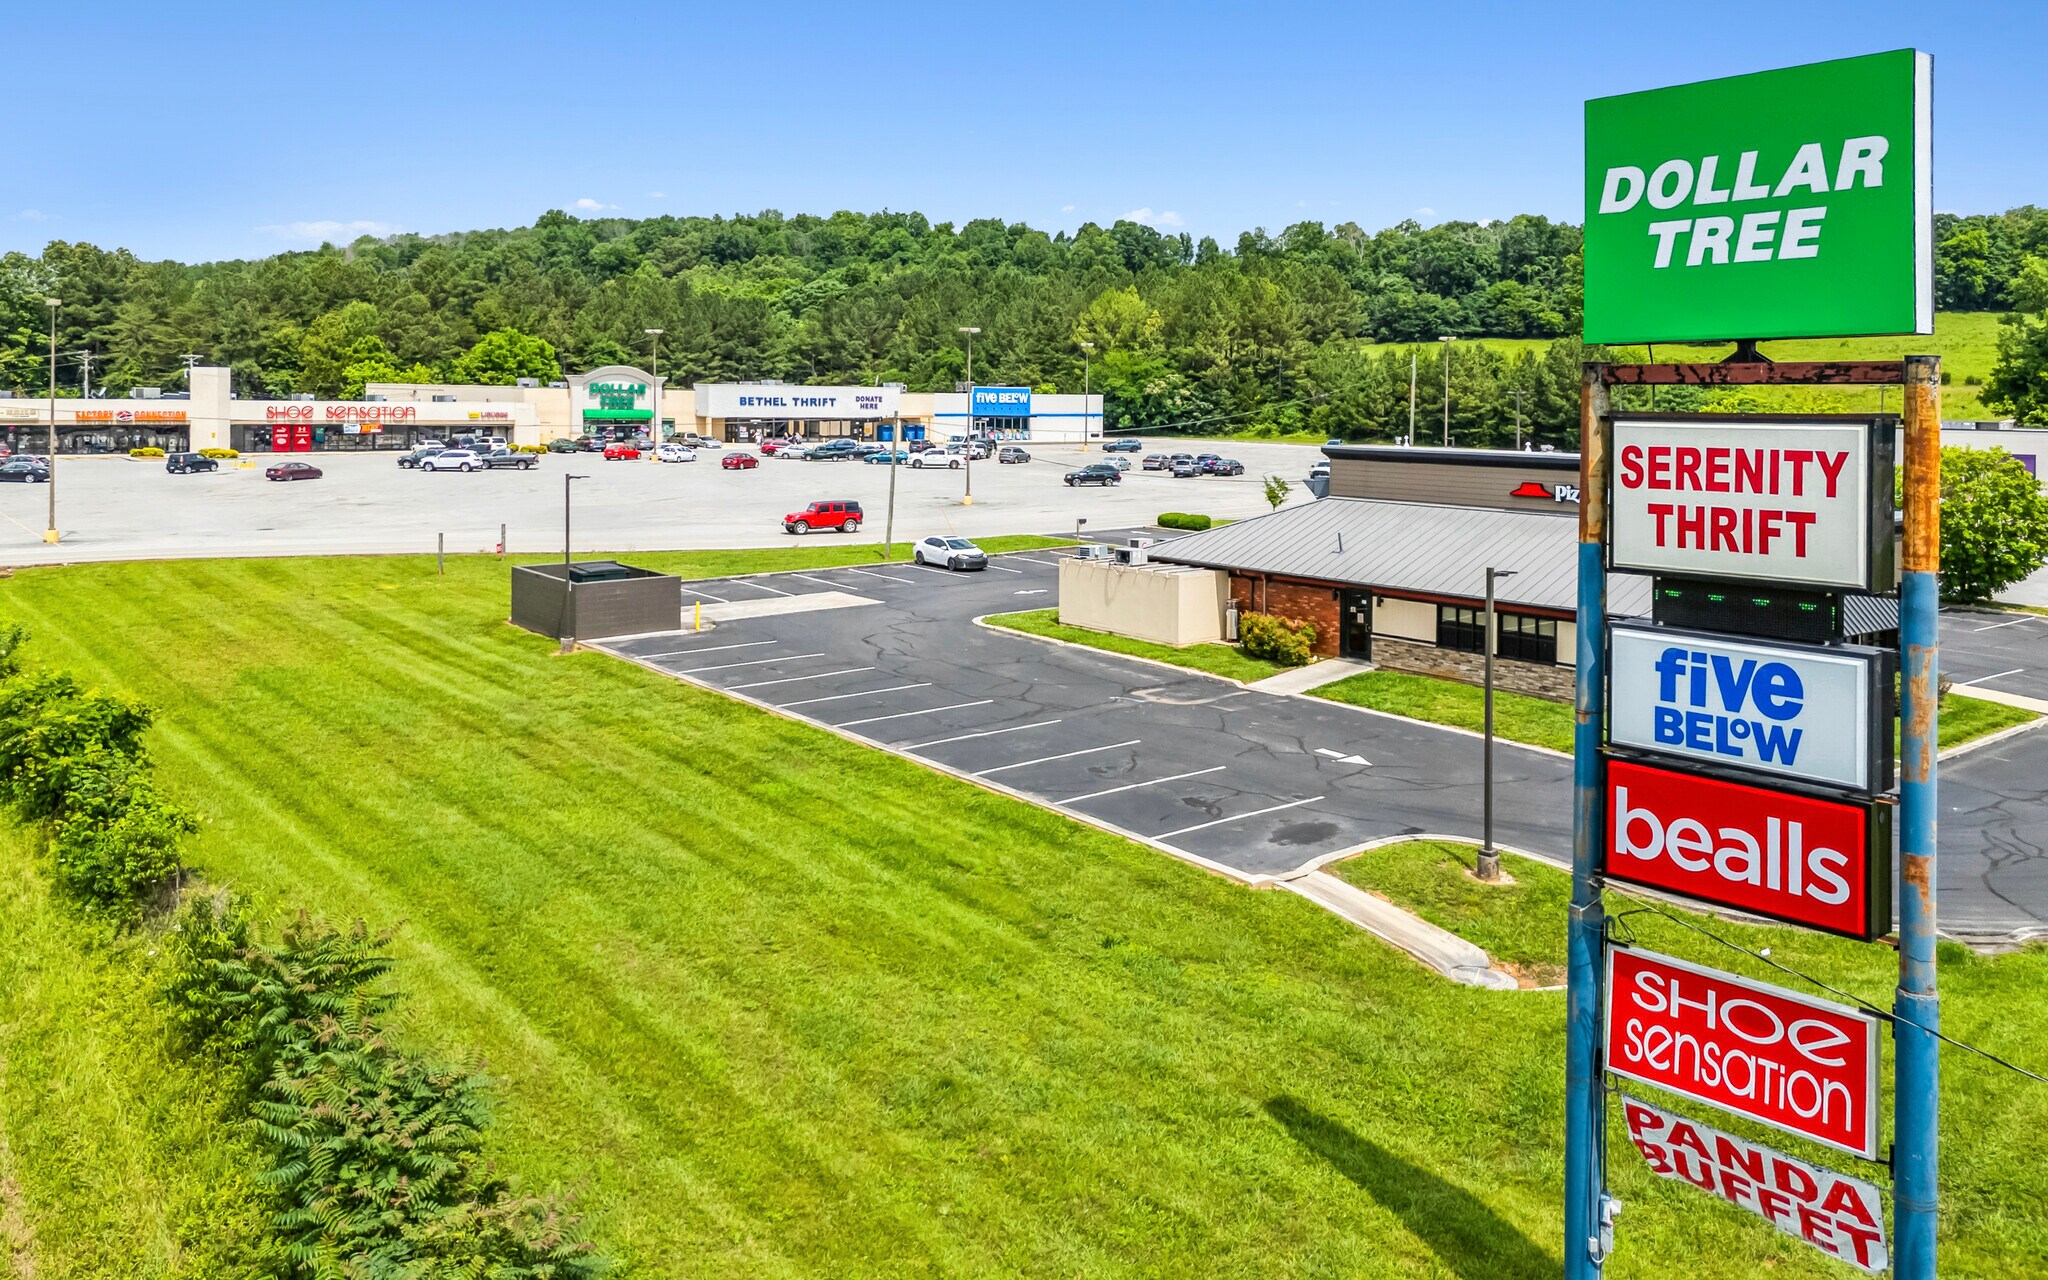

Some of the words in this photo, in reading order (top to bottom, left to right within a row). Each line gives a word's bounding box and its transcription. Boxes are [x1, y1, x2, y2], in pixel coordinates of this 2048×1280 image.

[1599, 135, 1889, 214] DOLLAR
[1648, 206, 1827, 269] TREE
[589, 382, 646, 395] DOLLAR
[739, 396, 787, 407] BETHEL
[792, 397, 836, 407] THRIFT
[976, 392, 997, 403] five
[999, 392, 1028, 403] BELOW
[1620, 445, 1849, 498] SERENITY
[1648, 503, 1816, 558] THRIFT
[1655, 647, 1804, 721] five
[1654, 706, 1803, 766] BELOW
[1615, 785, 1850, 905] bealls
[1625, 1103, 1879, 1228] PANDA
[1632, 1135, 1881, 1268] BUFFET
